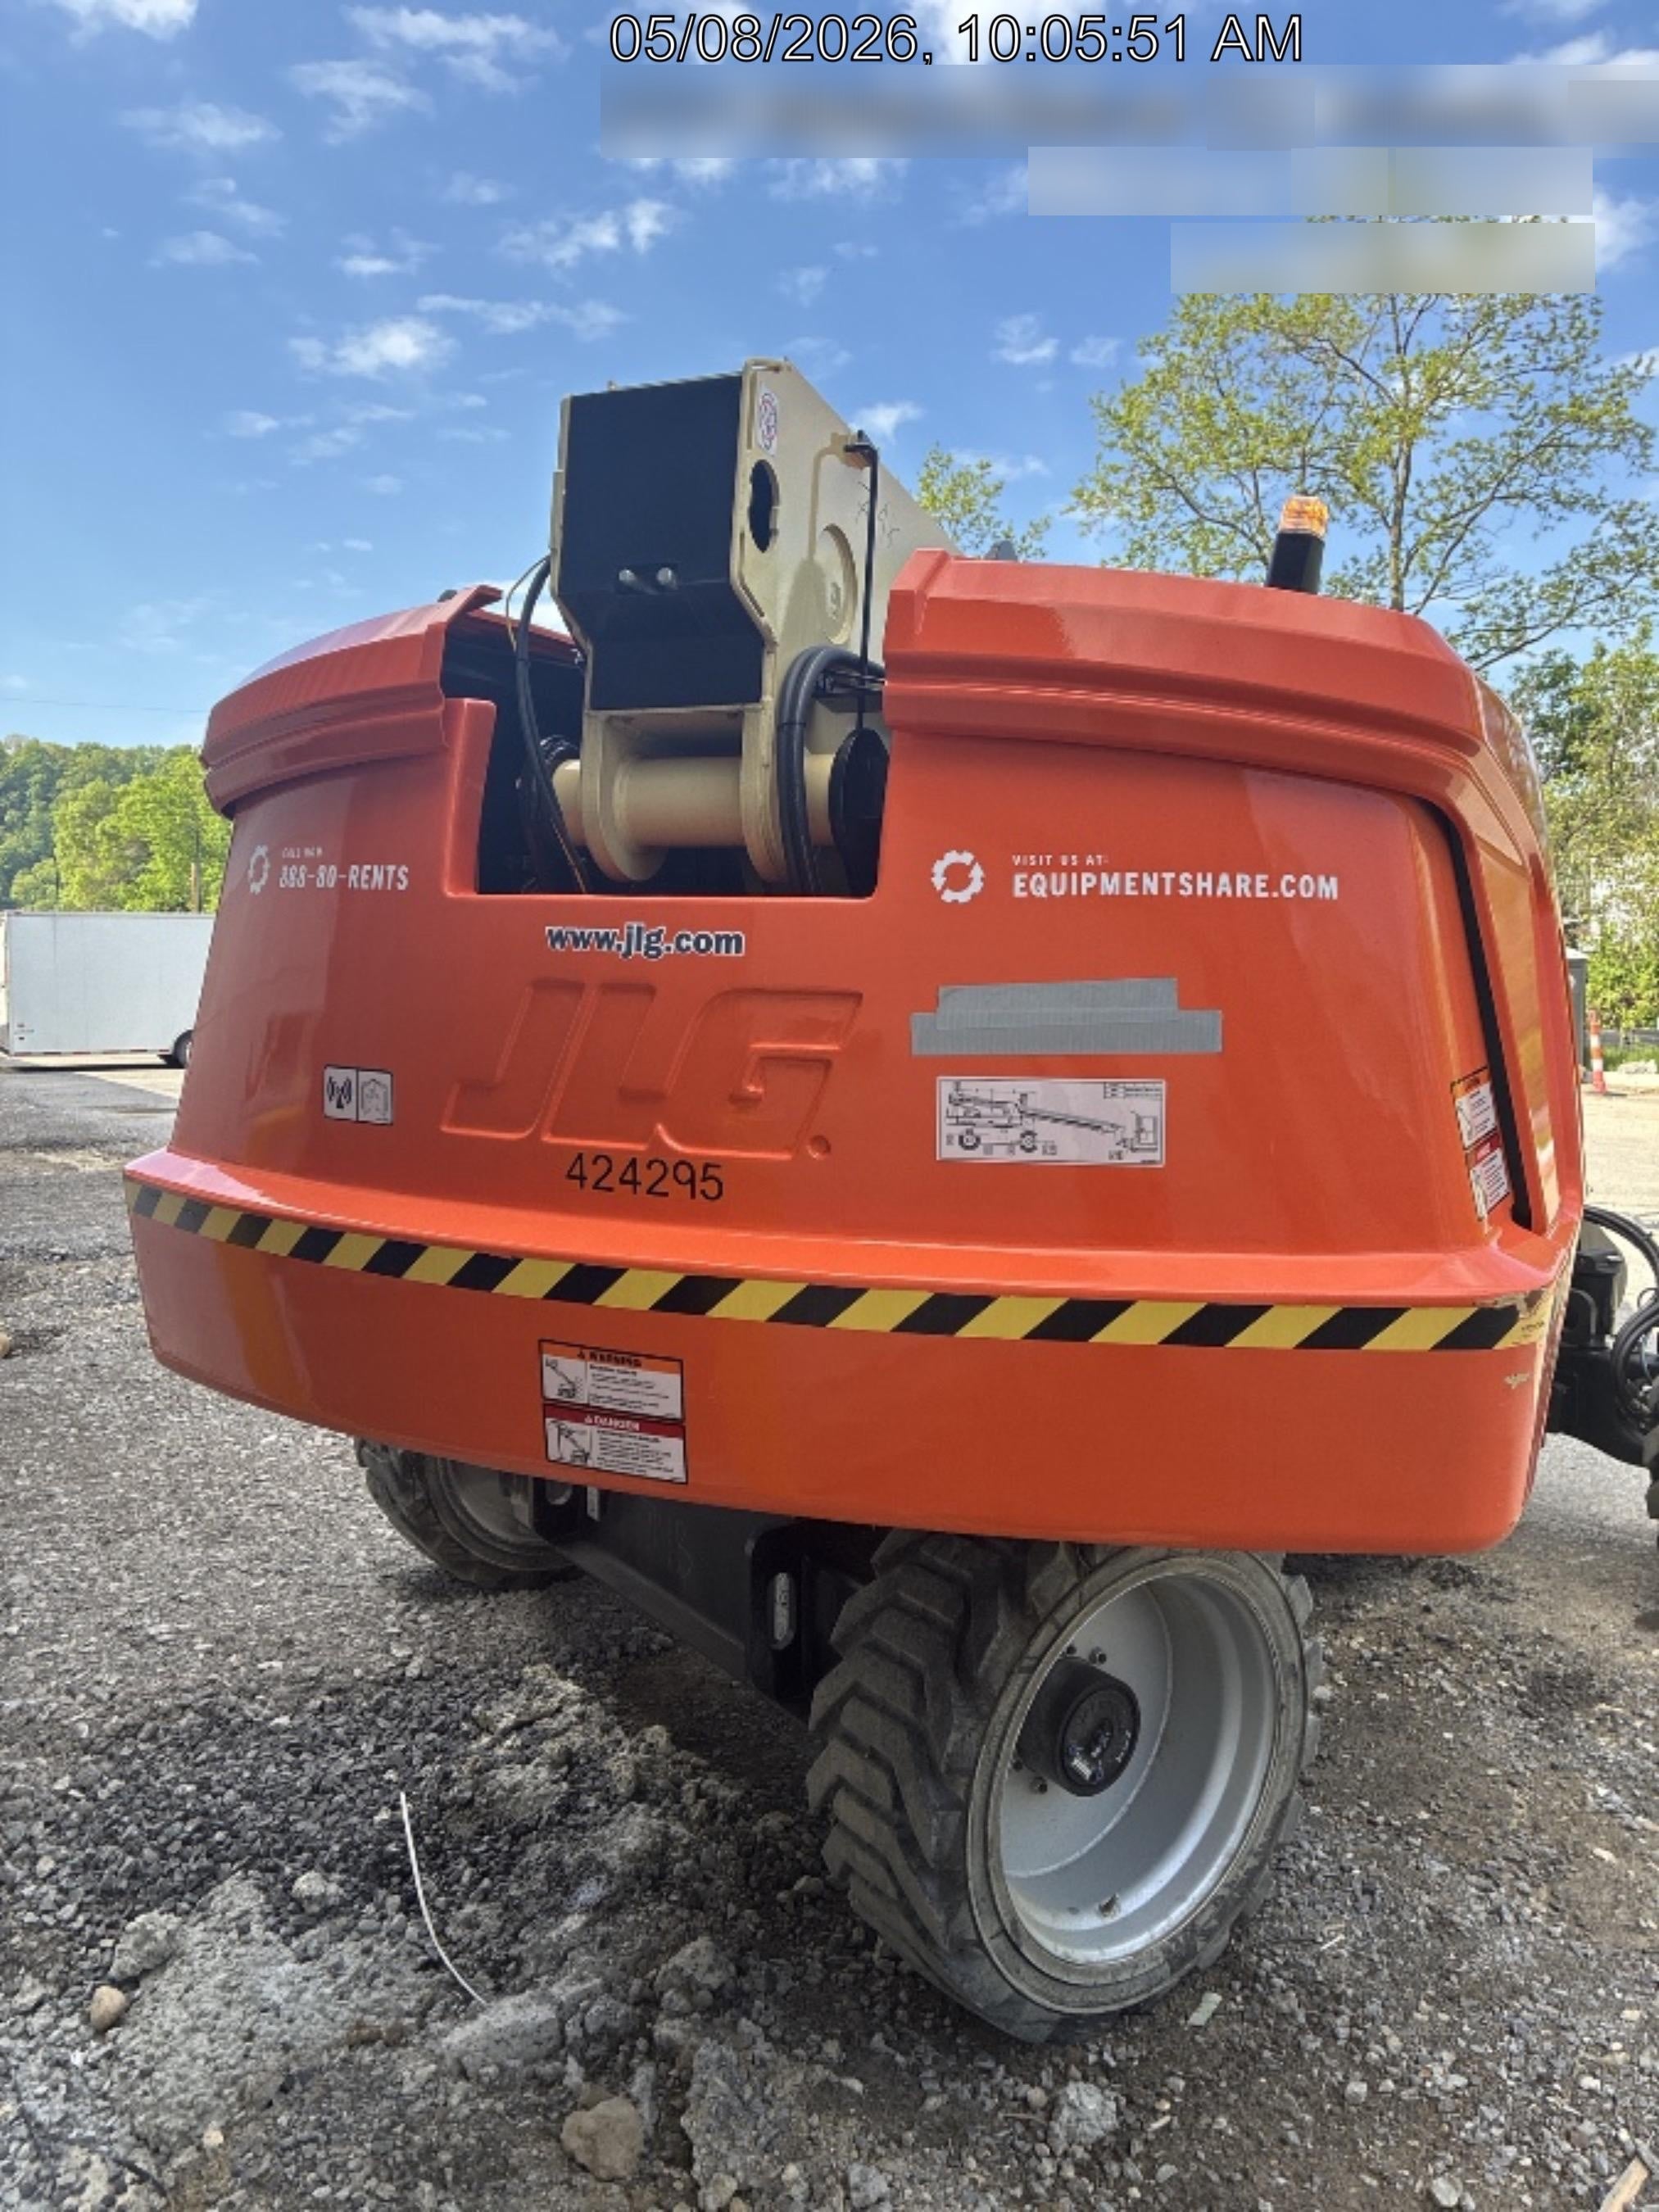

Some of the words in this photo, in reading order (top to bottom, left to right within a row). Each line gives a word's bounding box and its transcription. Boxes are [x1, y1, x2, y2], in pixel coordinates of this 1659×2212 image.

[1013, 854, 1052, 866] VISIT
[1061, 854, 1078, 866] US
[1013, 872, 1338, 900] EQUIPMENTSHARE.COM
[546, 922, 745, 959] www.jlg.com
[440, 979, 863, 1158] JLG
[566, 1154, 723, 1201] 424295
